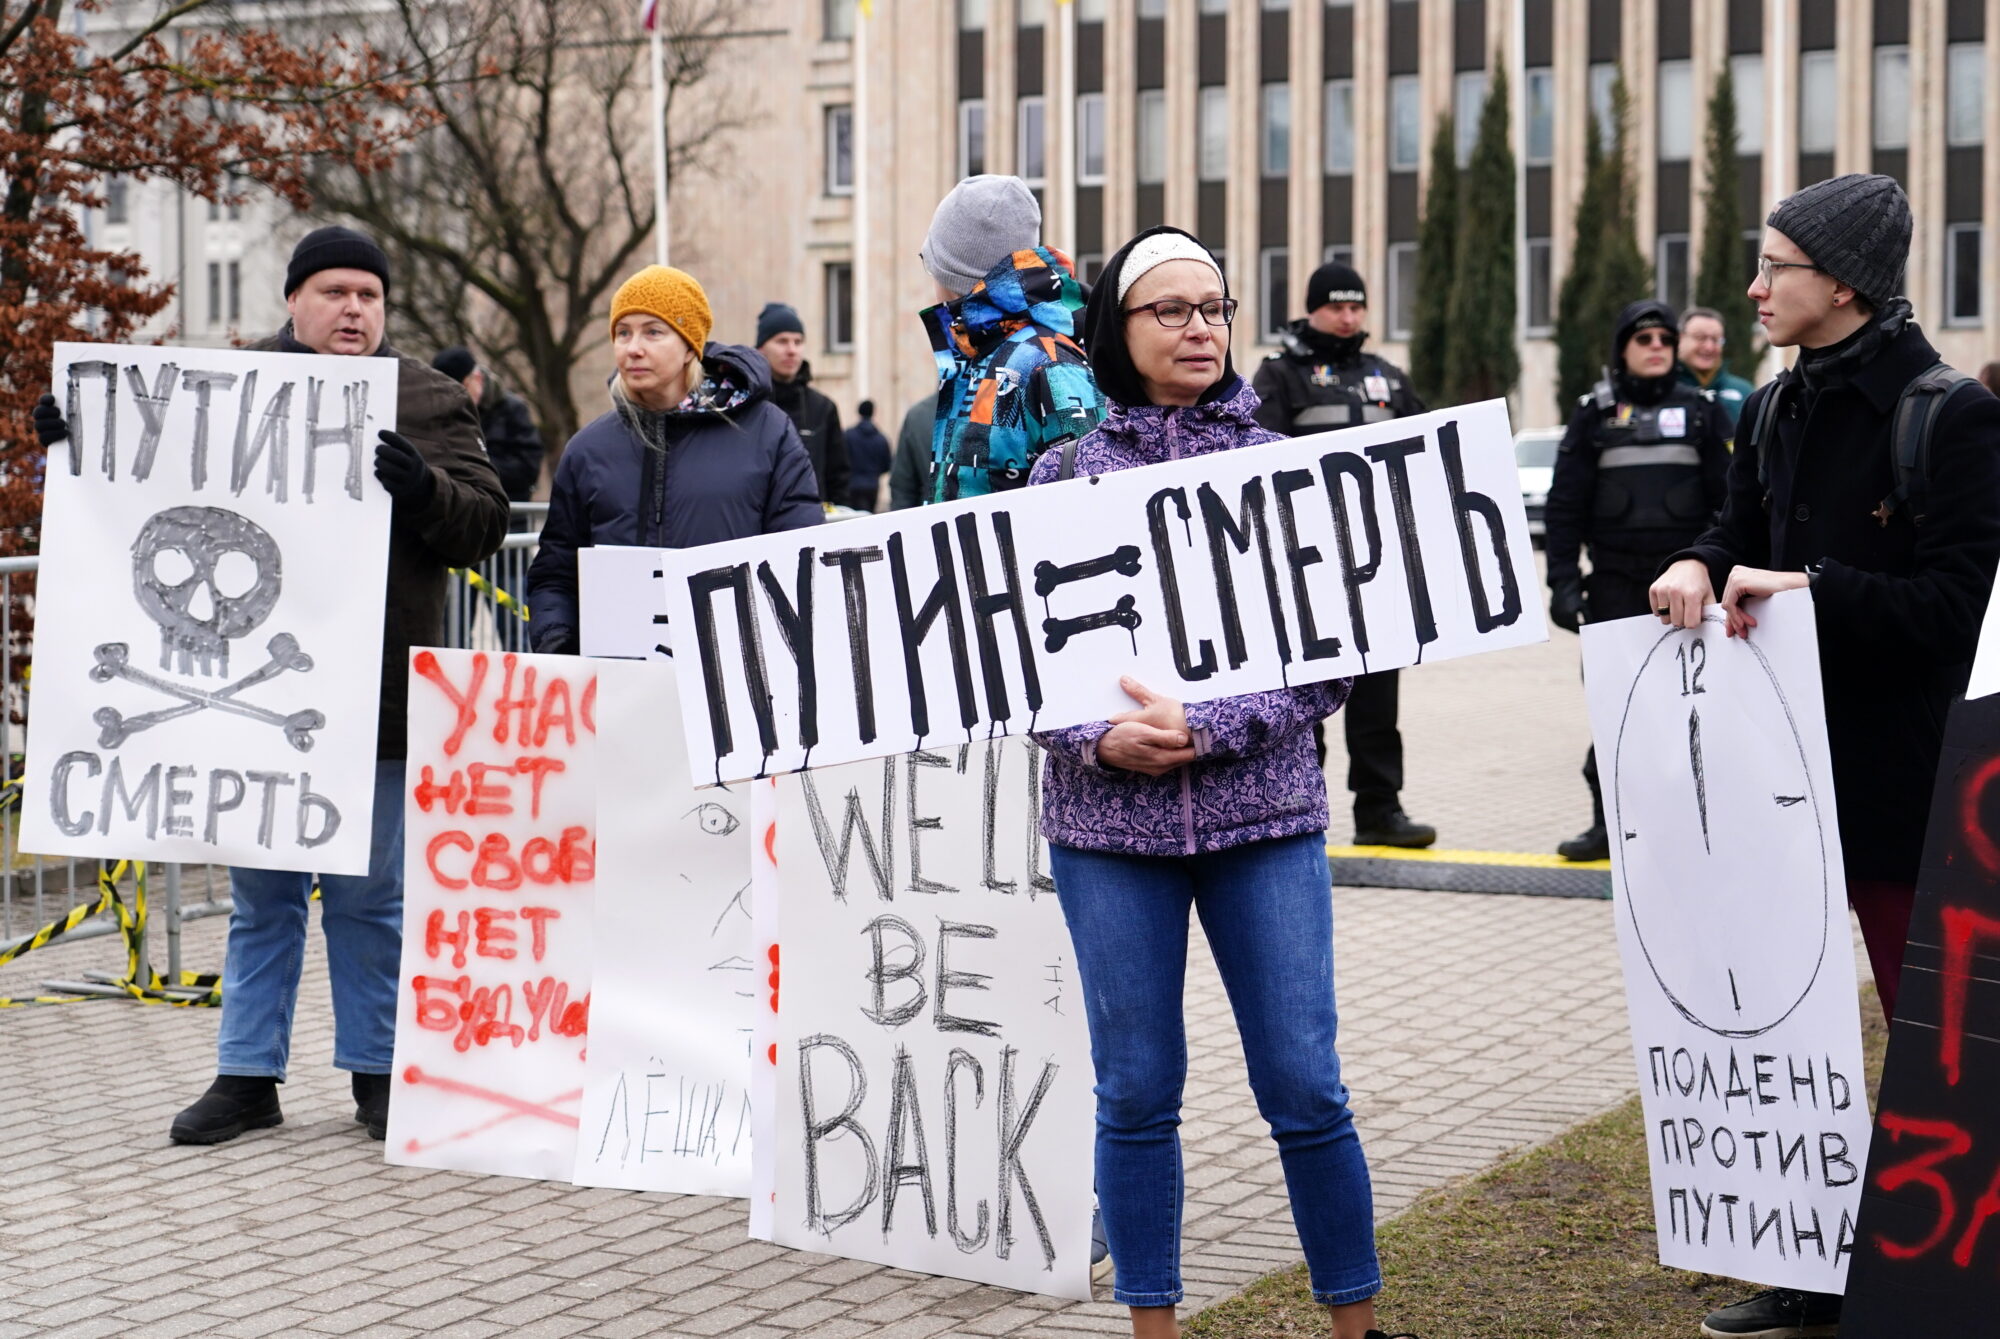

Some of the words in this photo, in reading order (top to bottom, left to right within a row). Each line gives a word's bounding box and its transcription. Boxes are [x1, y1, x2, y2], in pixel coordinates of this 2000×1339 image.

[67, 360, 368, 504] ПУТИН
[687, 511, 1042, 760] ПУТИН
[1146, 420, 1522, 684] СМЕРТЬ
[1675, 636, 1707, 698] 12
[49, 749, 342, 850] СМЕРТЬ
[413, 755, 566, 820] НЕТ
[800, 739, 1057, 904] WE'LL
[424, 825, 597, 892] СВОБ
[424, 905, 561, 969] НЕТ
[860, 914, 1003, 1039] BE
[1648, 1045, 1851, 1116] ПОЛДЕНЬ
[798, 1032, 1060, 1272] BACK
[1659, 1116, 1859, 1188] ПРОТИВ
[1668, 1187, 1854, 1268] ПУТИНА
